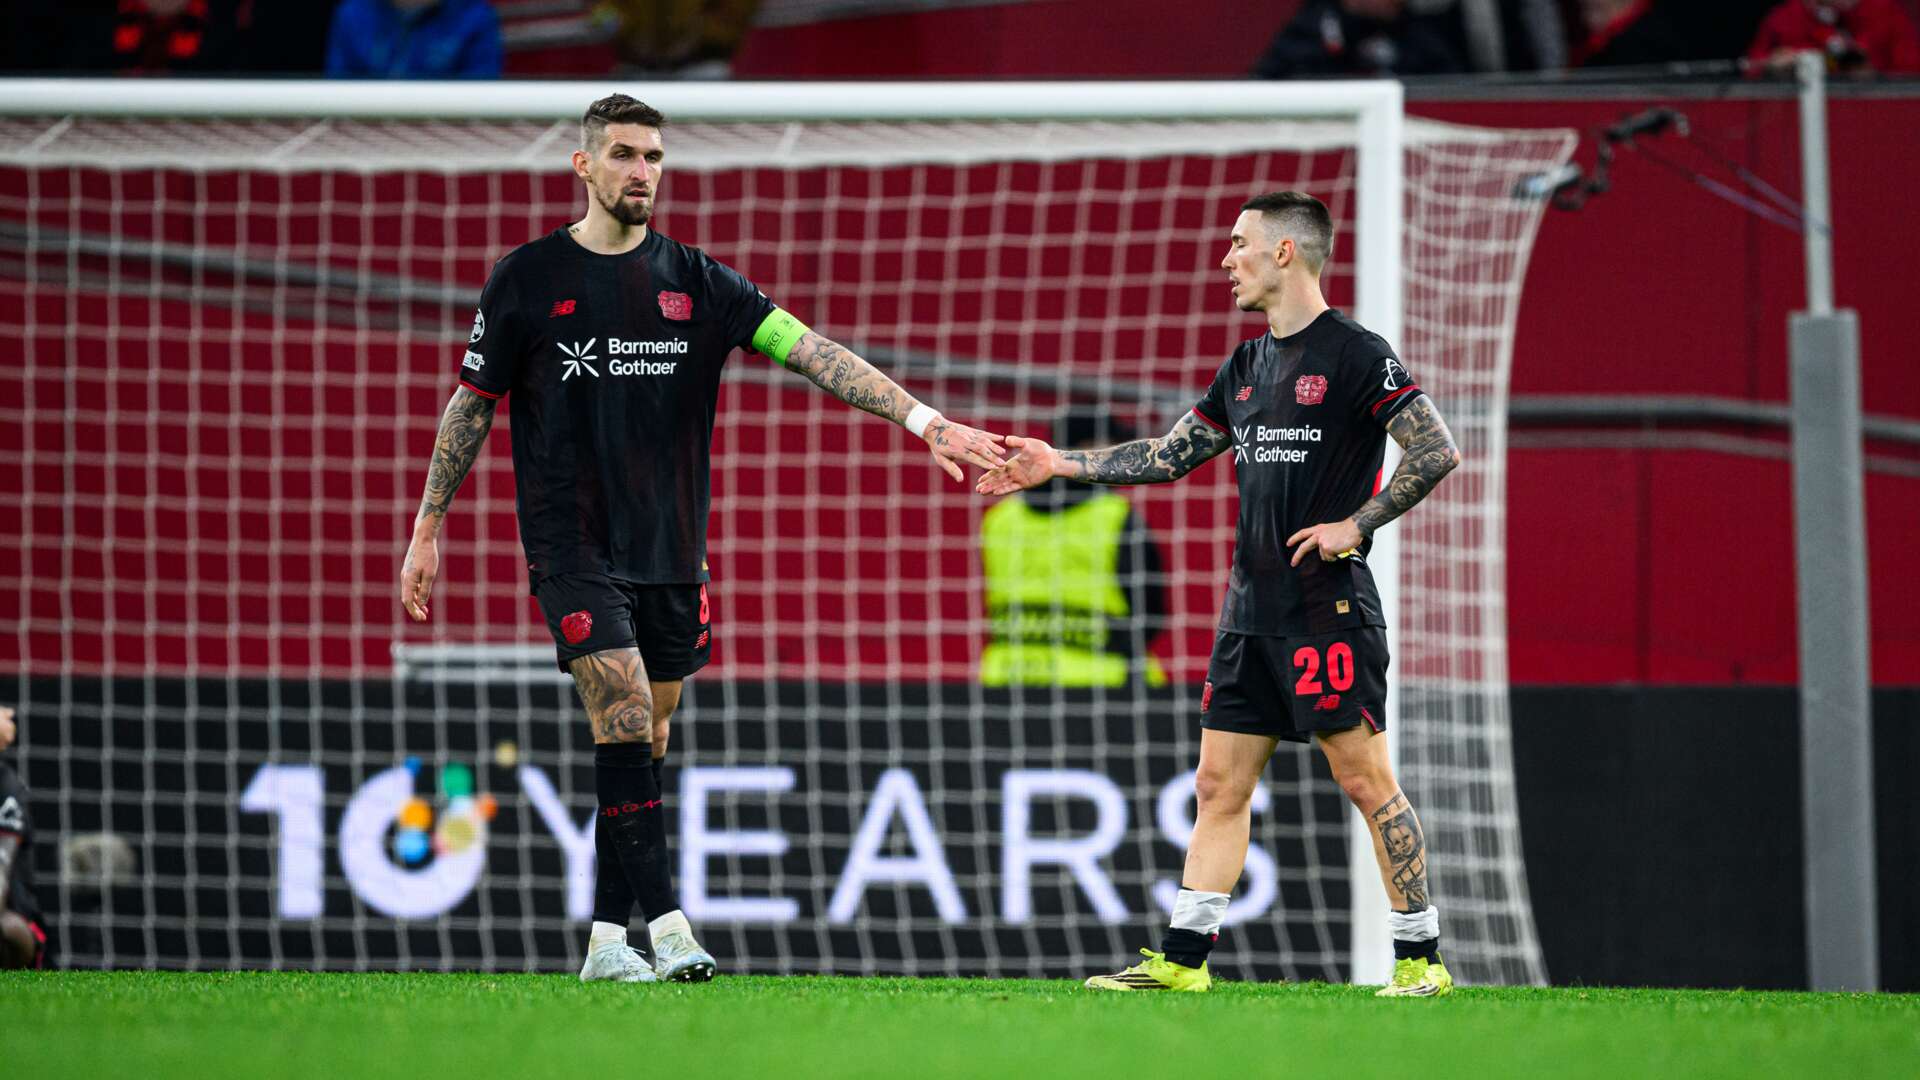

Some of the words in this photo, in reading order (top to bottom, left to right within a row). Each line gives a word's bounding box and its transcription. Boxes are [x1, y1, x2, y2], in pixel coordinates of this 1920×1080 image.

[608, 337, 688, 354] Barmenia
[608, 359, 677, 376] Gothaer
[1256, 424, 1322, 442] Barmenia
[1255, 446, 1308, 463] Gothaer
[699, 583, 710, 625] 8
[1293, 641, 1355, 696] 20
[516, 764, 1279, 926] YEARS
